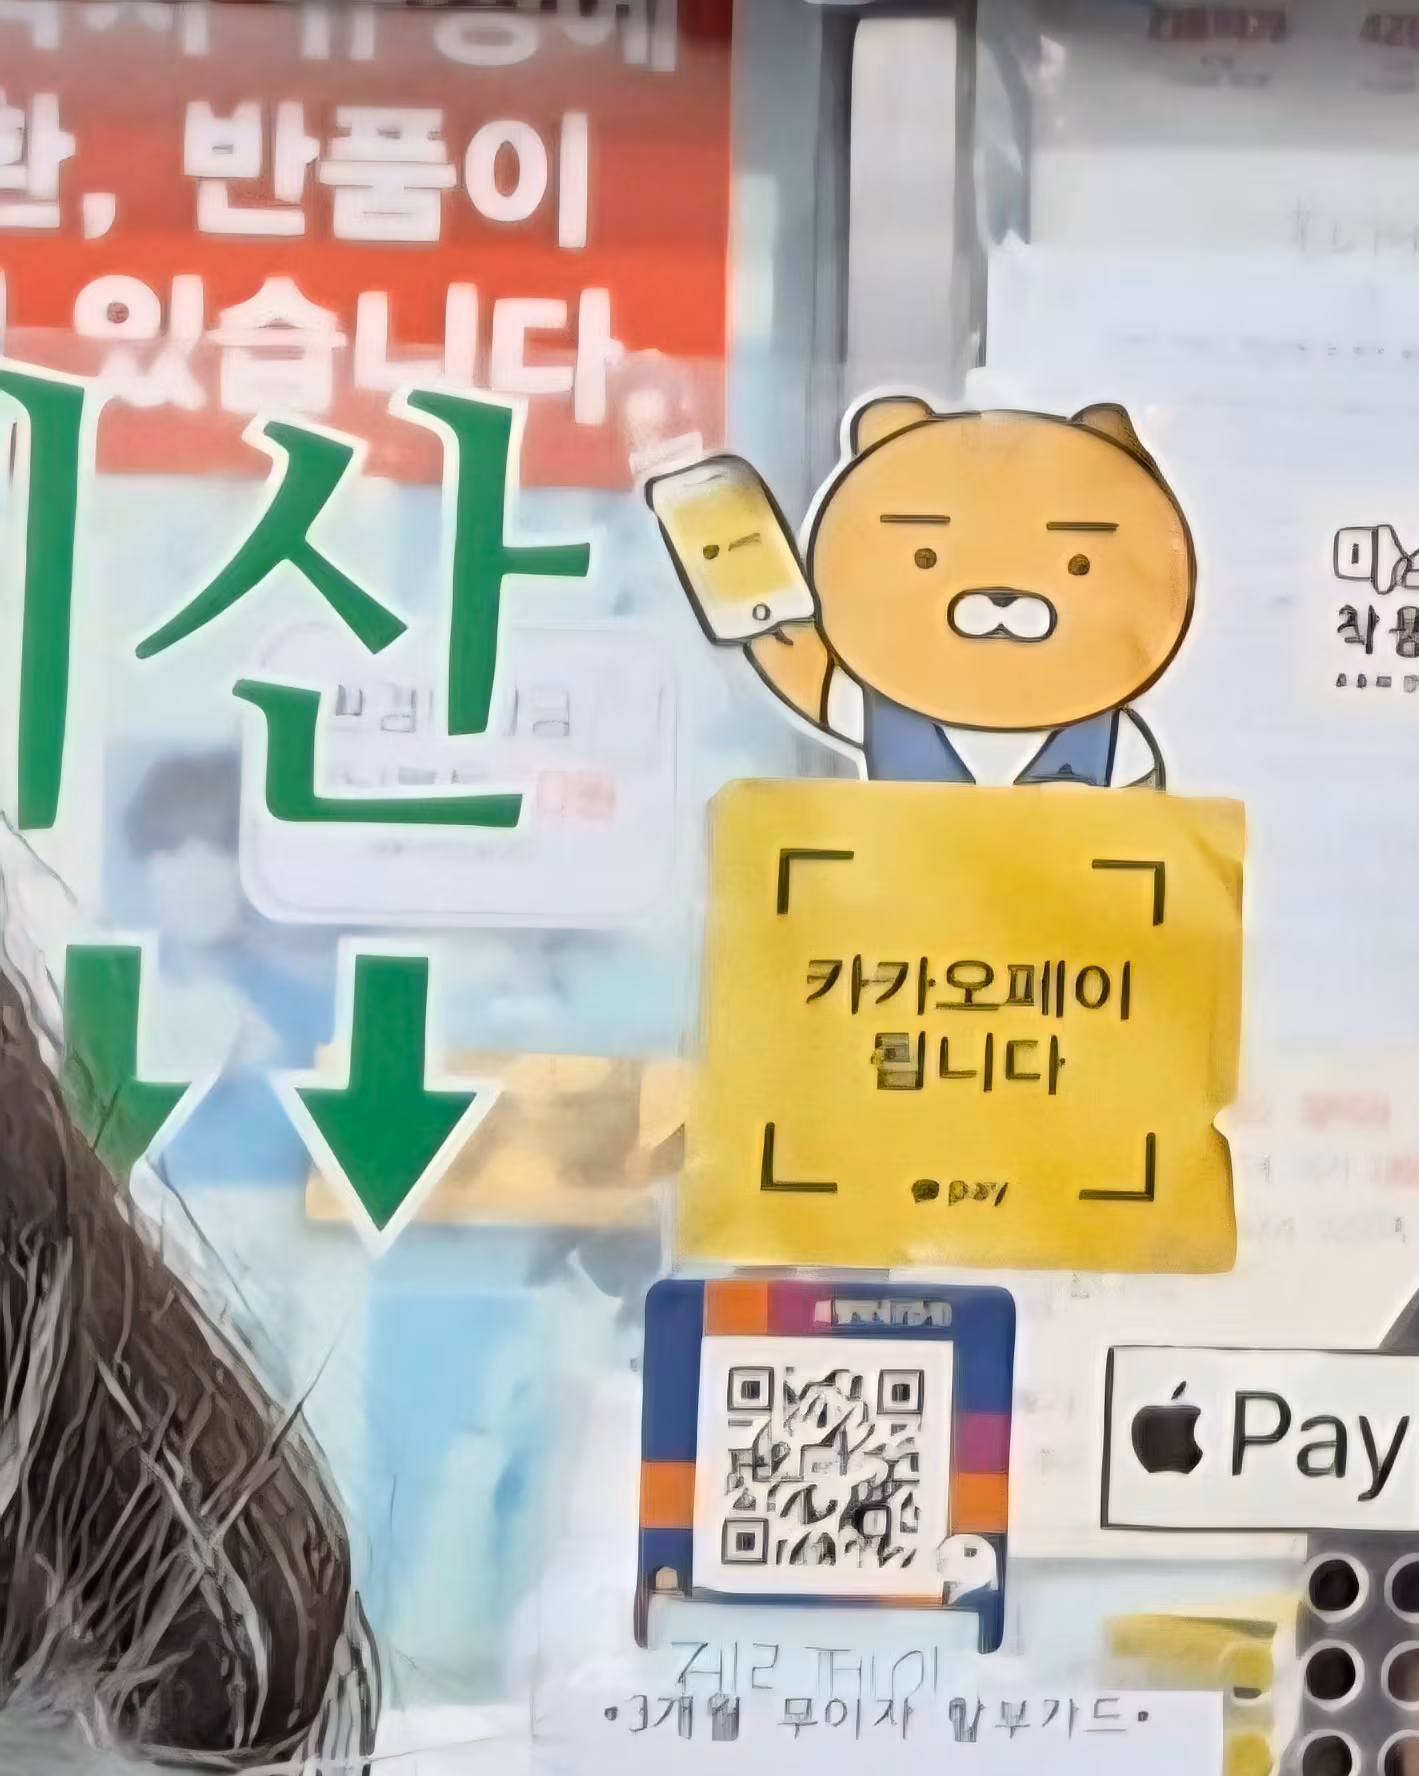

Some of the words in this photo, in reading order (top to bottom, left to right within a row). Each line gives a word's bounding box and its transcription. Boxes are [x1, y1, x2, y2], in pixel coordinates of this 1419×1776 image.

[184, 98, 589, 249] 반품이
[0, 368, 590, 829] 산
[805, 954, 1132, 1021] 카카오페이
[870, 1030, 1067, 1096] 됩니다
[1231, 1390, 1411, 1503] Pay
